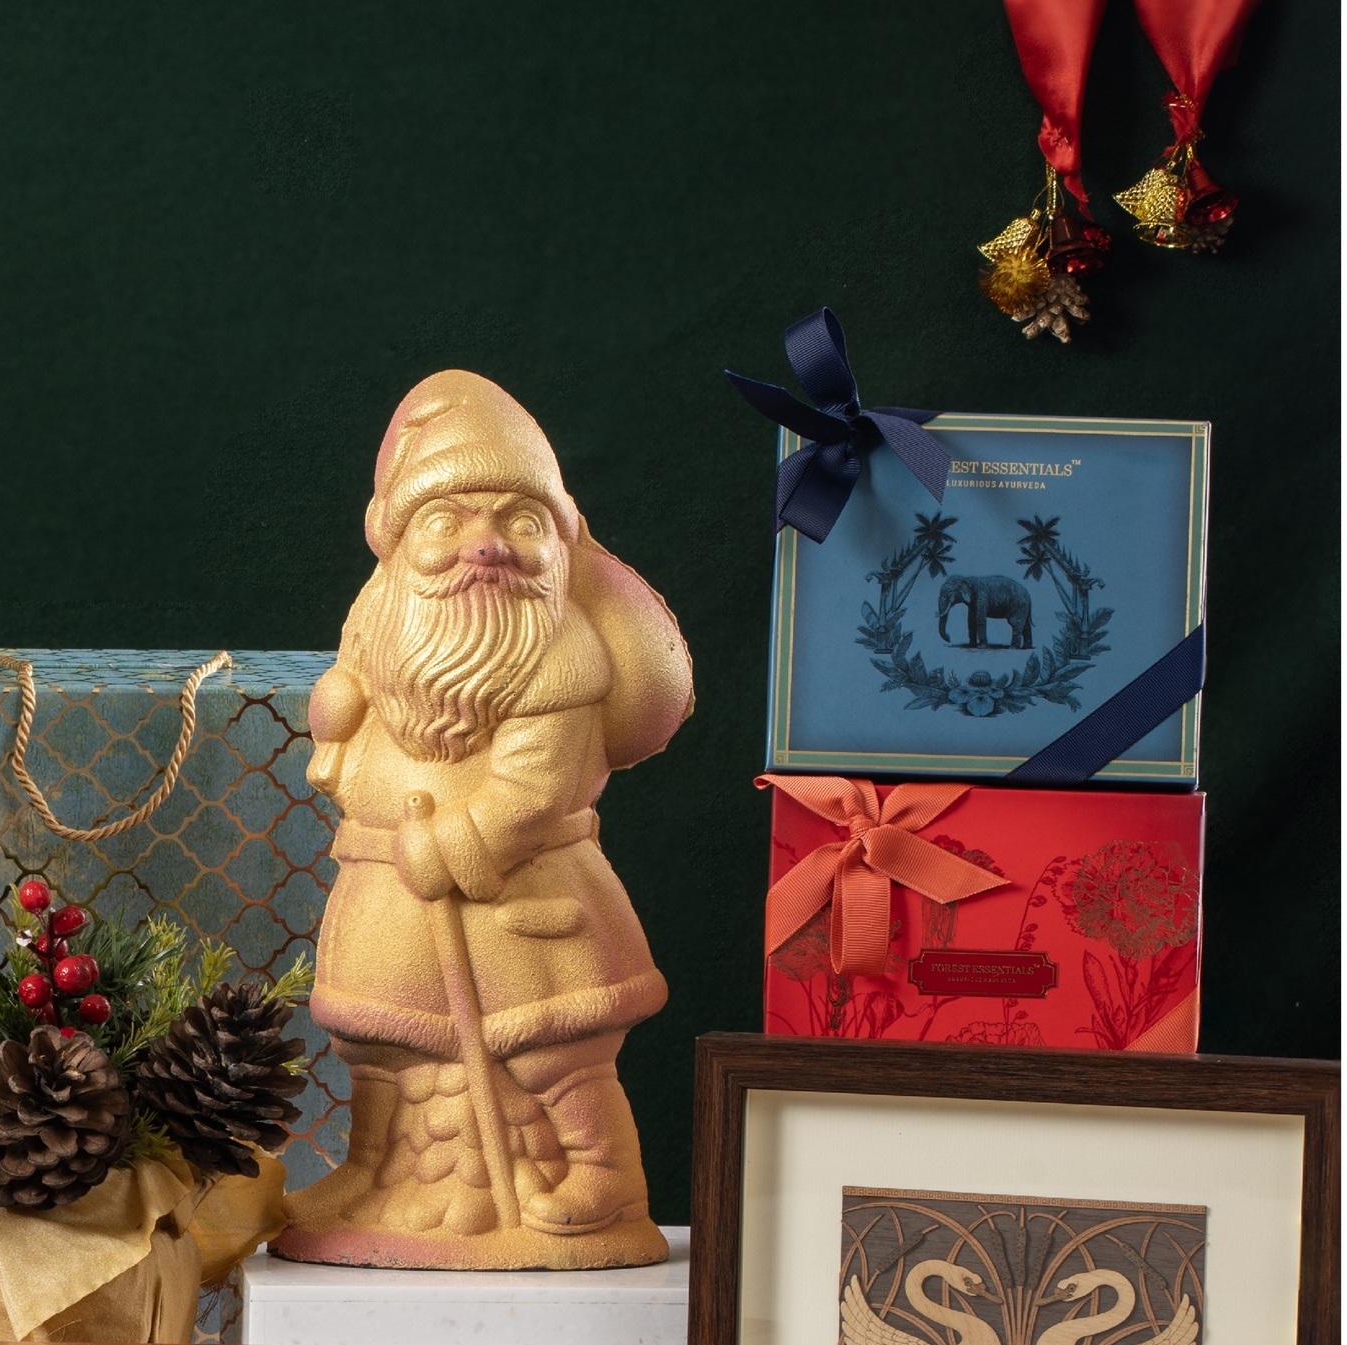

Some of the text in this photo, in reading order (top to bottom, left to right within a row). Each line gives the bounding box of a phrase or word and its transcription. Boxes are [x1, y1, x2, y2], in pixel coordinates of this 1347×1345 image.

[949, 460, 1073, 477] EST ESSENTIALS
[946, 480, 1046, 489] LUXURIOUS AYURVEDA
[931, 963, 1034, 975] FOREST ESSENTIALS
